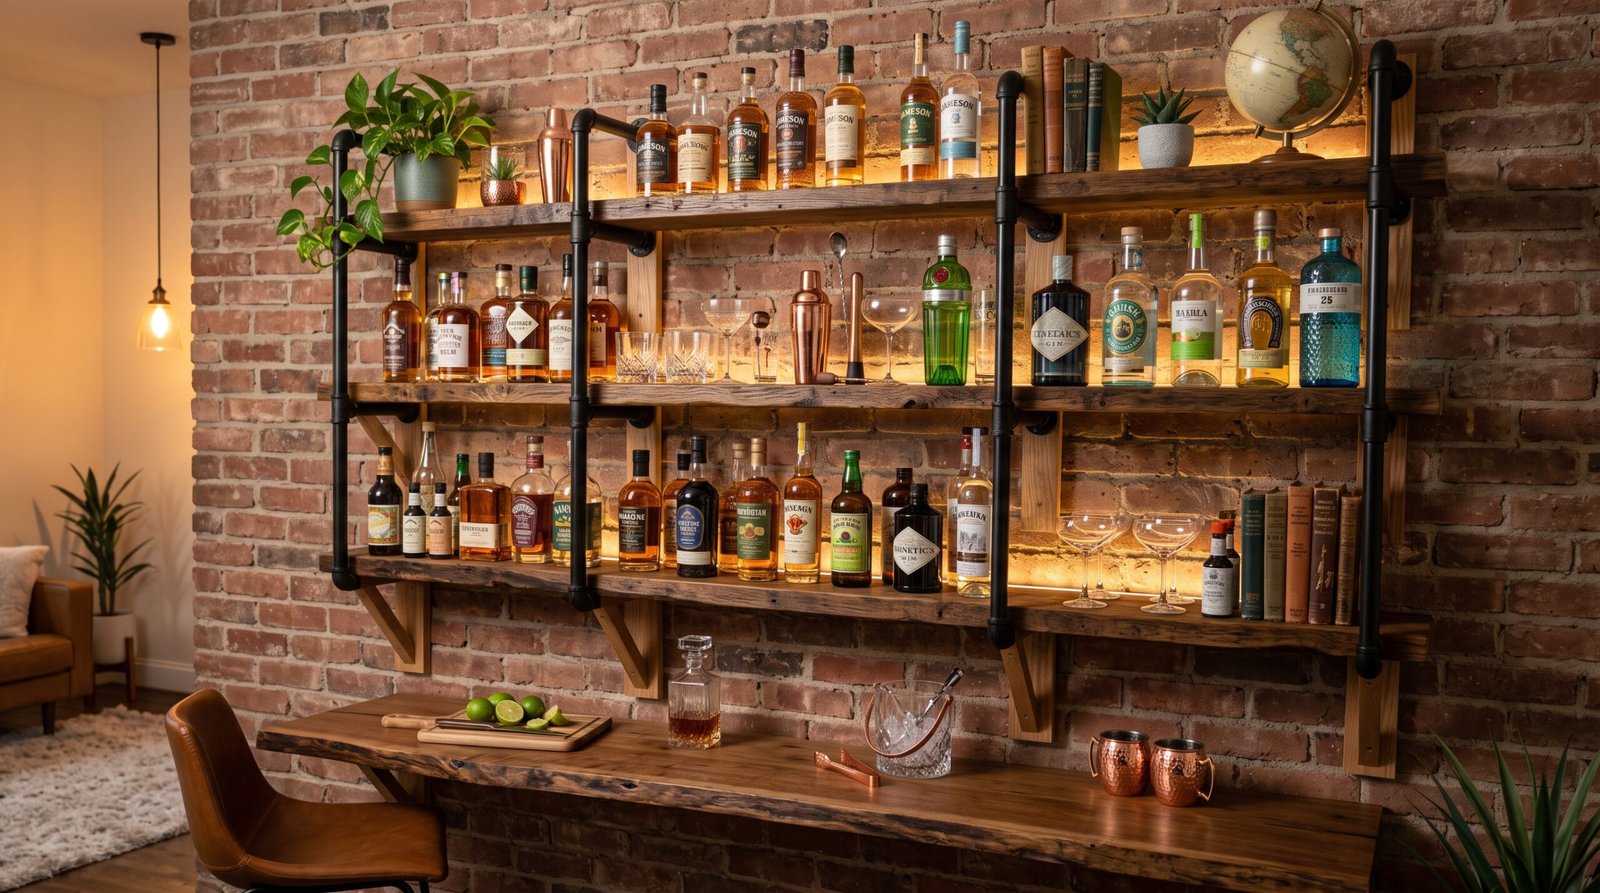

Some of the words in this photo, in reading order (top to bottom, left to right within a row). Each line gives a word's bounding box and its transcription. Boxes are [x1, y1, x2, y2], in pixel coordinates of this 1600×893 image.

[776, 115, 805, 128] JAMESON
[728, 127, 758, 140] JAMESON
[1320, 296, 1333, 304] 25
